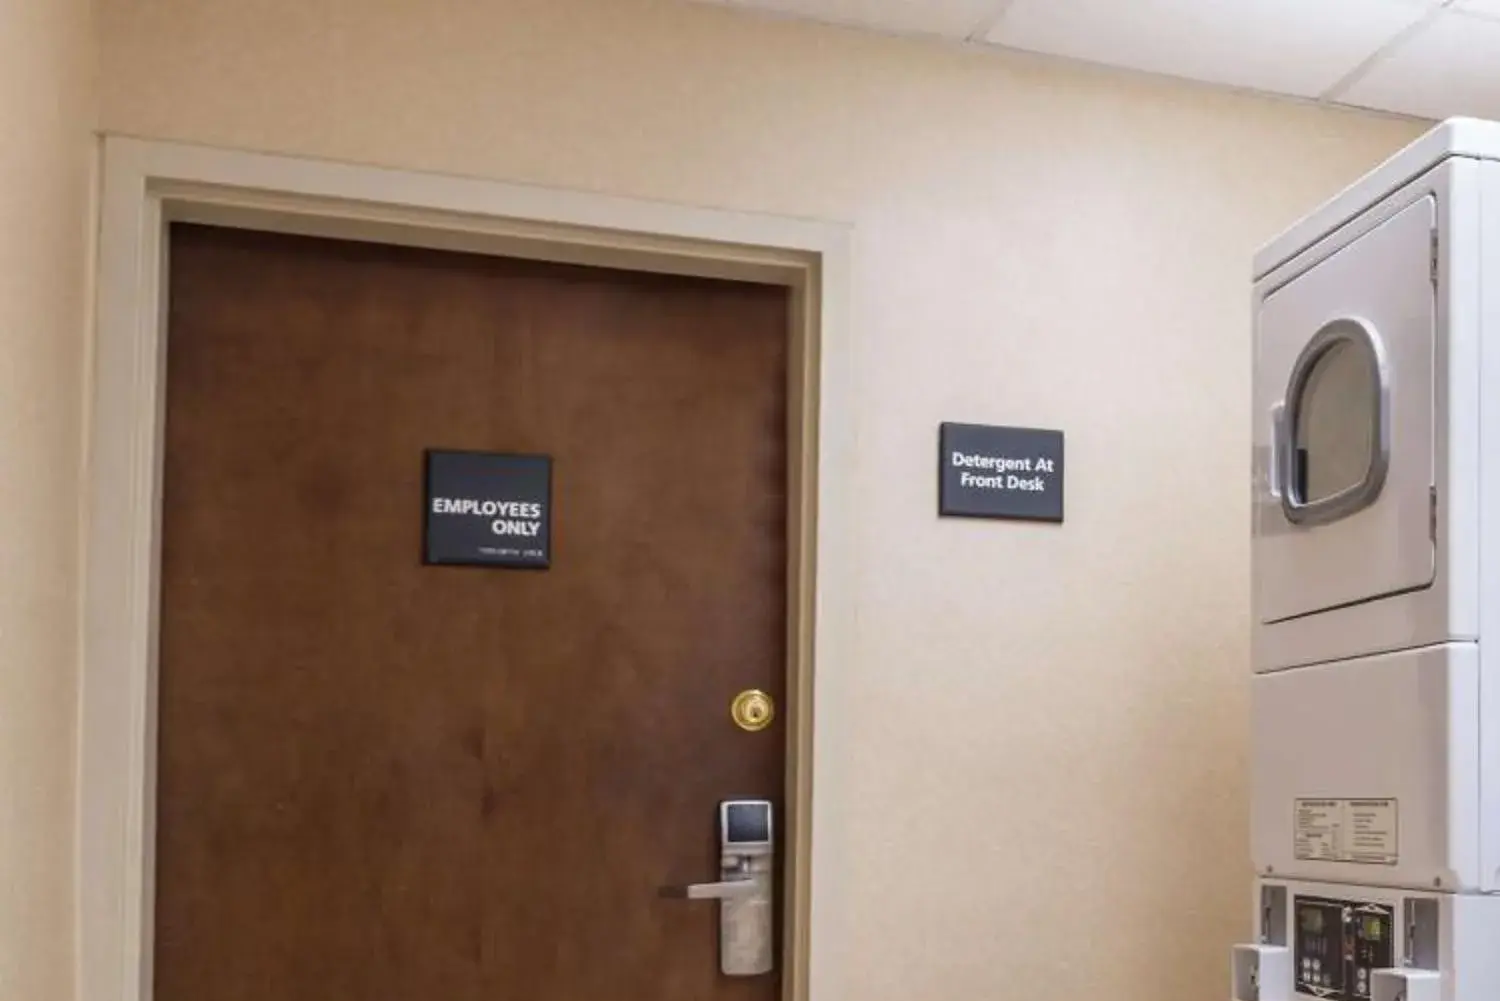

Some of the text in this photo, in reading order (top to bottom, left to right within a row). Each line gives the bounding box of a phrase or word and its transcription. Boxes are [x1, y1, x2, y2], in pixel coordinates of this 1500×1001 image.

[952, 452, 1054, 472] Detergent At
[961, 472, 1044, 491] Front Desk
[432, 497, 541, 518] EMPLOYEES
[492, 519, 541, 536] ONLY
